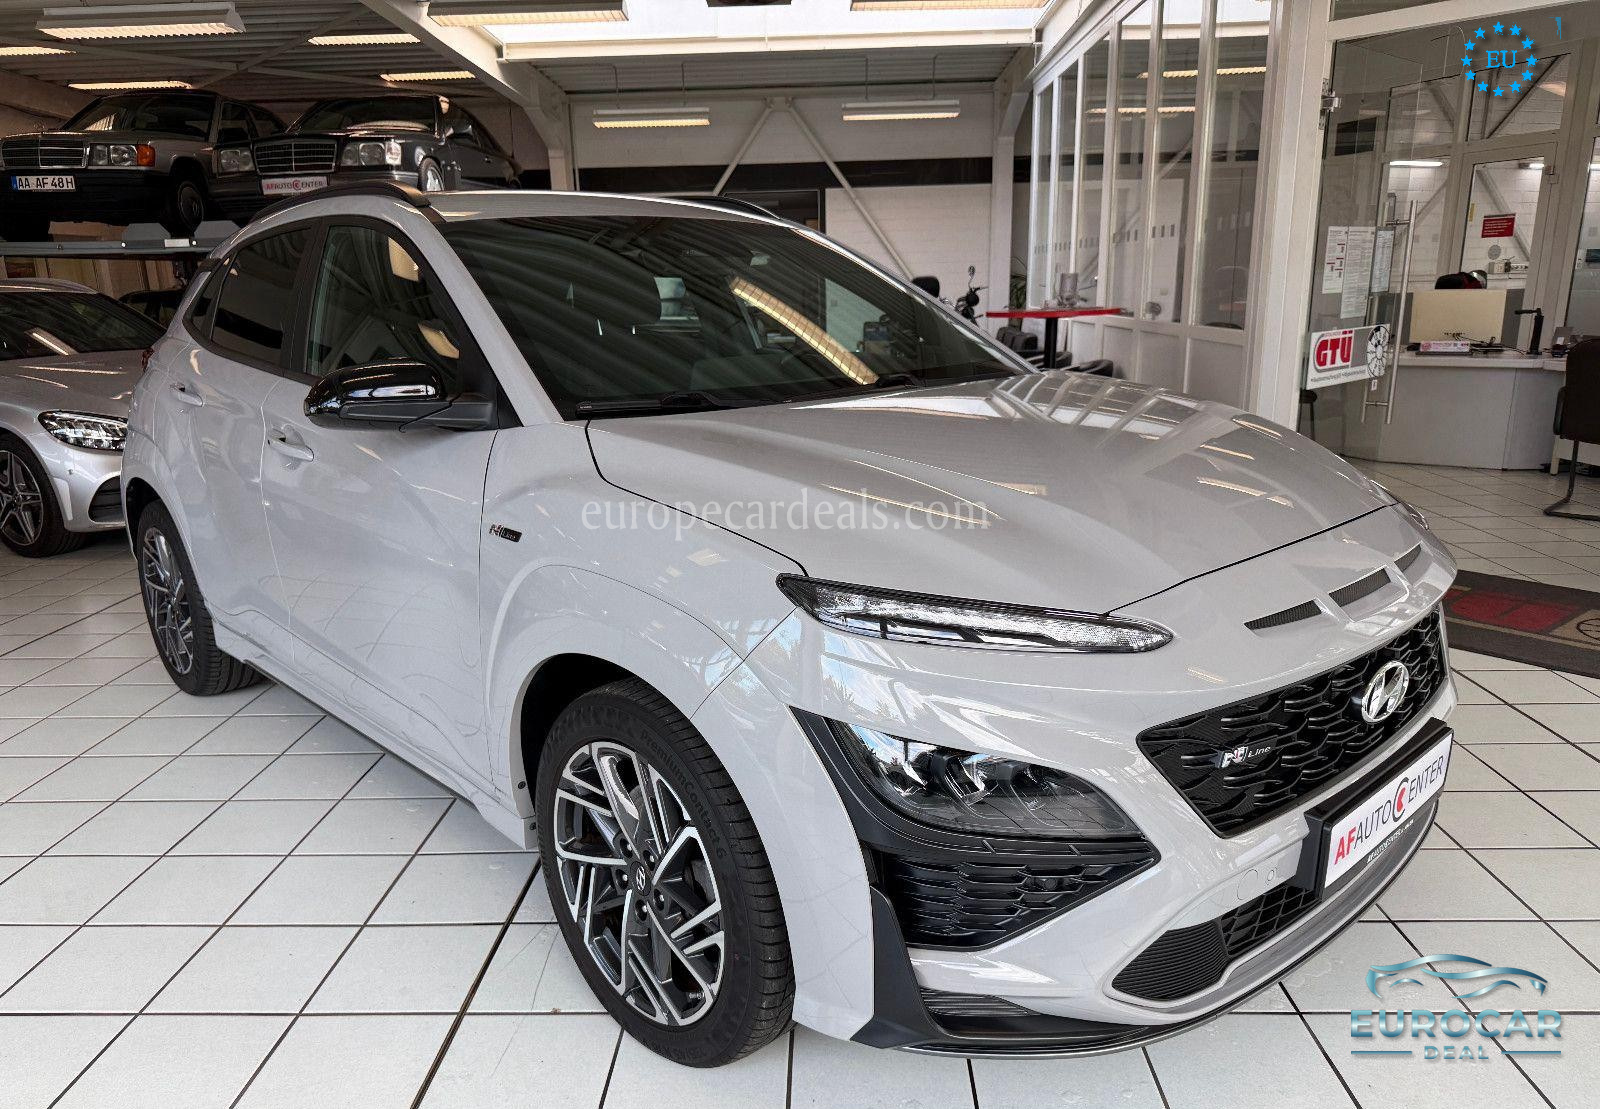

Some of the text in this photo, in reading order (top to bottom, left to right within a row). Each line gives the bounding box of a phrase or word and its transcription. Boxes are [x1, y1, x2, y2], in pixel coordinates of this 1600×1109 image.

[18, 177, 31, 189] AA
[36, 177, 49, 189] AF
[1316, 330, 1353, 367] GTÜ
[1247, 747, 1271, 758] Line
[640, 722, 728, 860] PremiumContact 6
